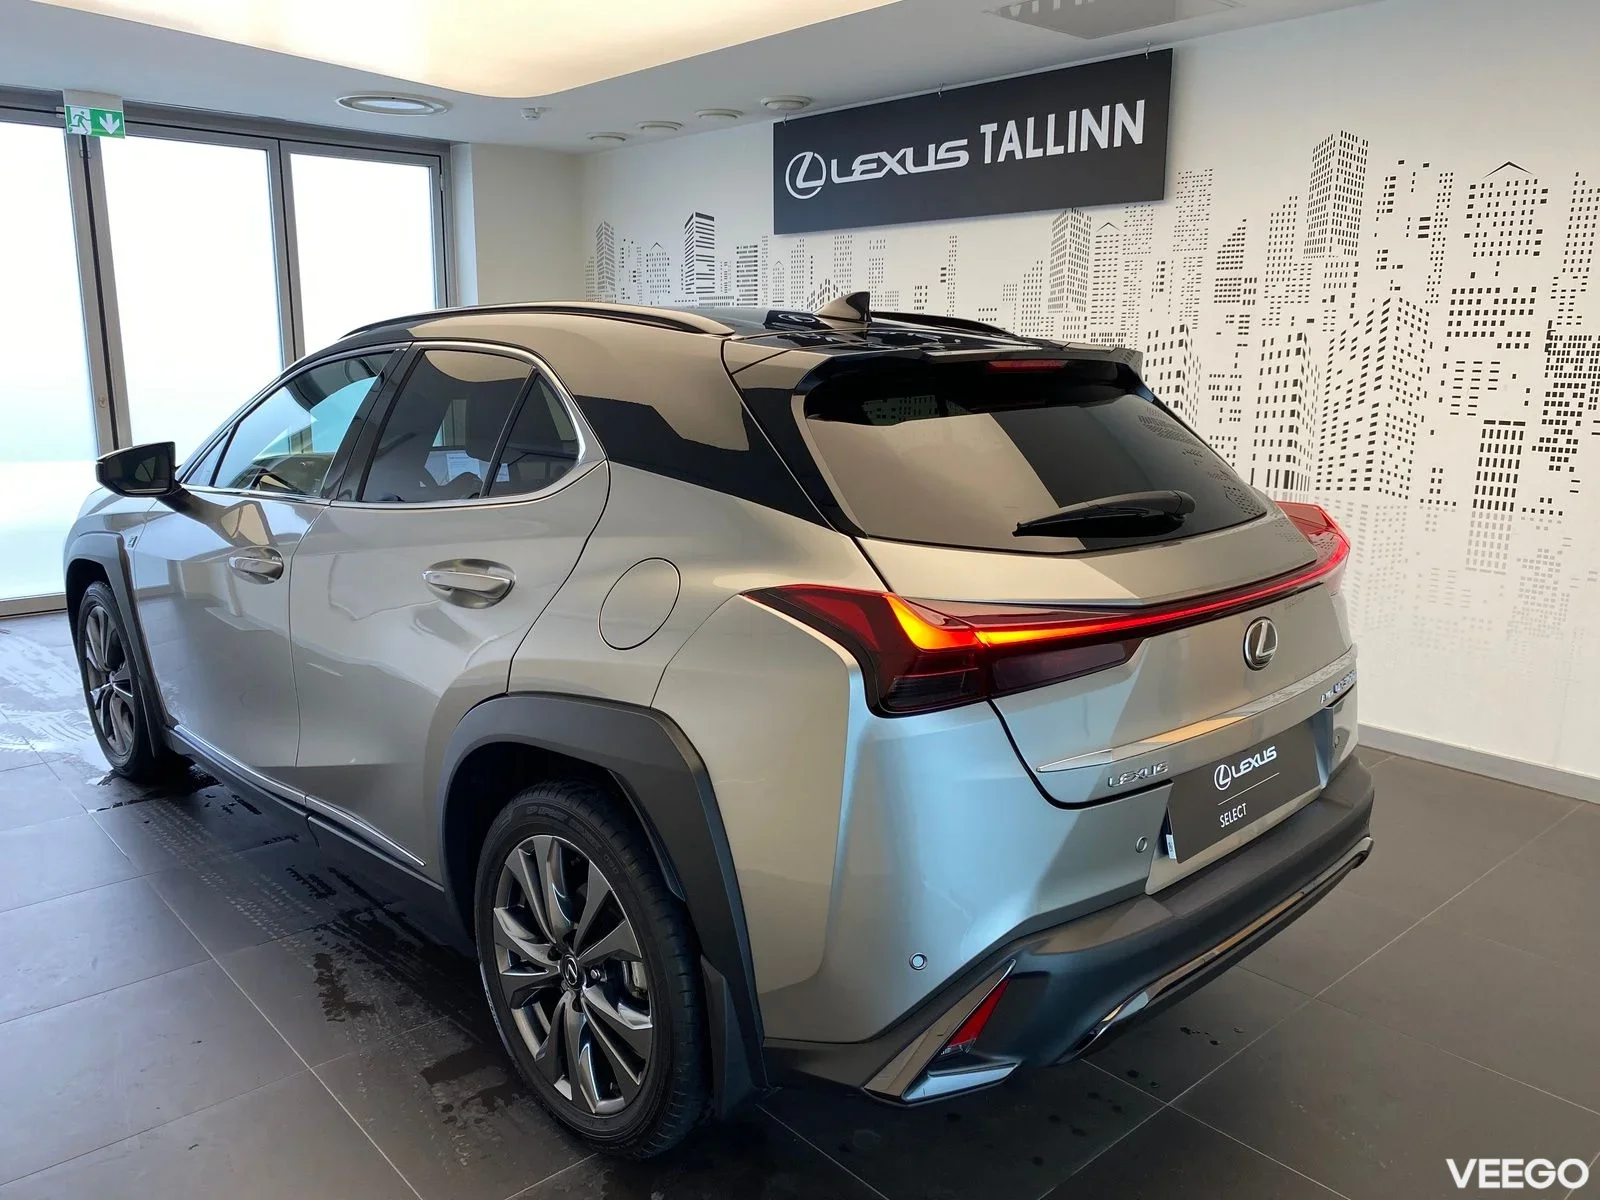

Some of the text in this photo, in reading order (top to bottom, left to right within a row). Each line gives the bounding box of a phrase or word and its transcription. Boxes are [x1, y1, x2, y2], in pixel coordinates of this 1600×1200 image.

[830, 138, 969, 184] LEXUS
[980, 99, 1145, 164] TALLINN
[1108, 761, 1168, 787] LEXUS
[1231, 745, 1277, 778] LEXUS
[1219, 802, 1247, 828] SELECT
